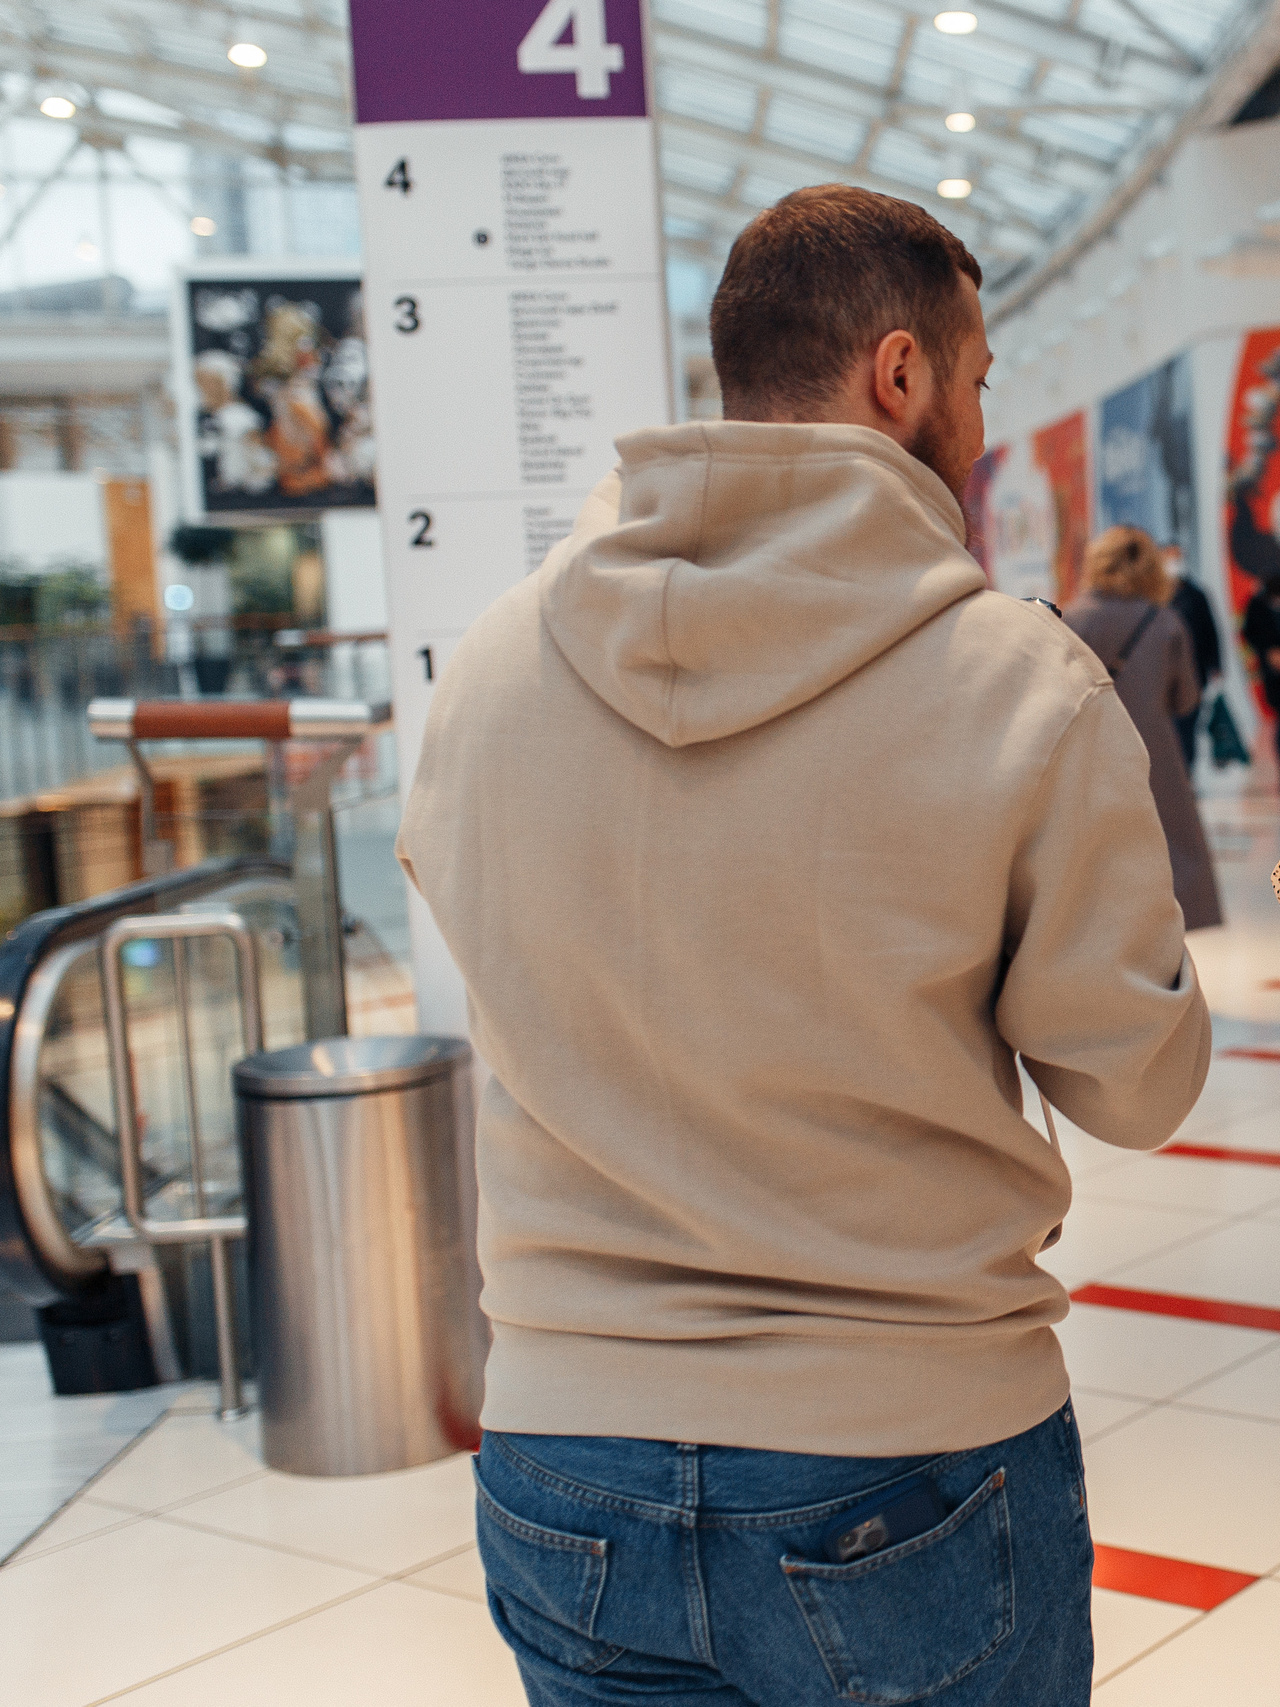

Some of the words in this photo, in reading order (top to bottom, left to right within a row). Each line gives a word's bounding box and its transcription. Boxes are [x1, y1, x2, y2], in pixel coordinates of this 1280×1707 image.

[517, 0, 624, 99] 4
[385, 158, 412, 195] 4
[394, 296, 421, 334] 3
[409, 510, 434, 549] 2
[418, 646, 434, 682] 1
